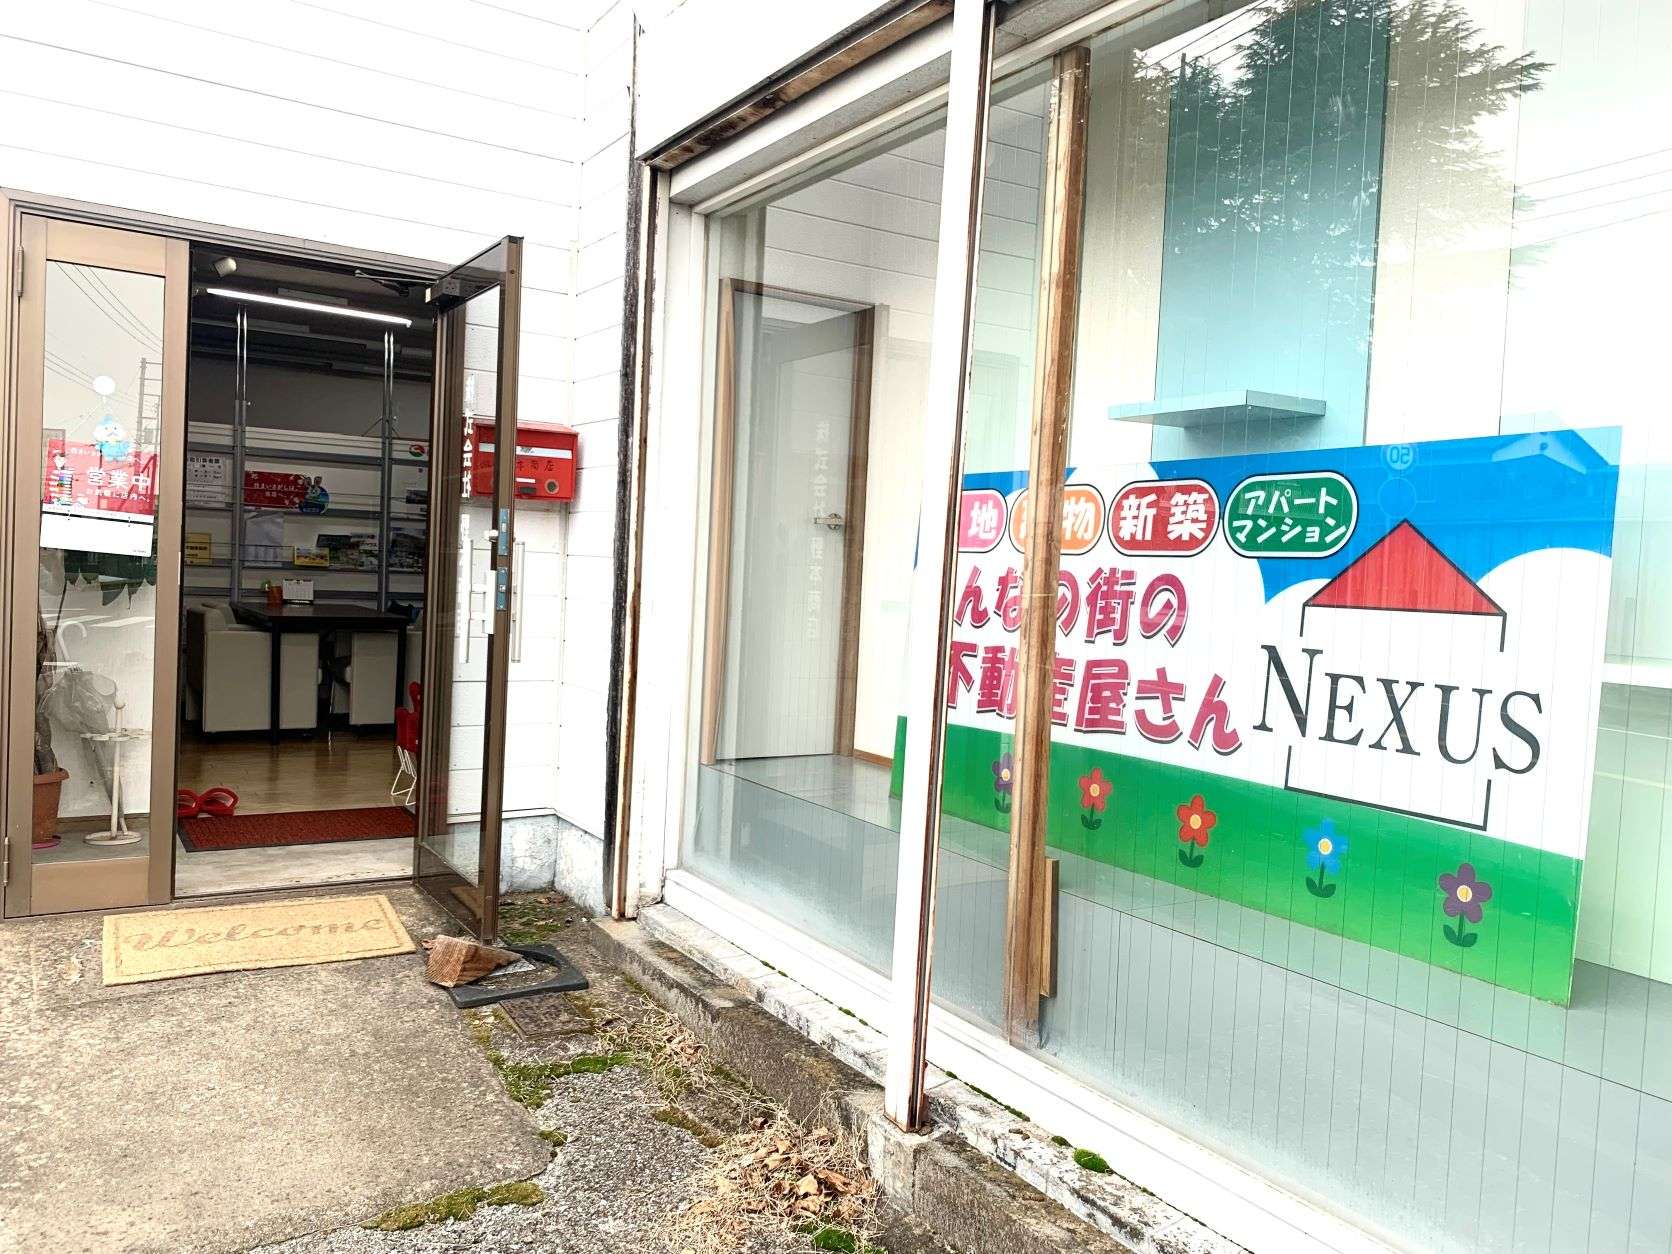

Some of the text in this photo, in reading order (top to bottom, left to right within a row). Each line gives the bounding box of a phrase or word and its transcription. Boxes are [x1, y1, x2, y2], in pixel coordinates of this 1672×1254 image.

[86, 467, 151, 492] 営業中
[1119, 491, 1209, 542] 新築
[1245, 487, 1338, 515] アパート
[1232, 516, 1347, 544] マンション
[1252, 644, 1543, 774] NEXUS
[122, 916, 385, 952] Welcome
